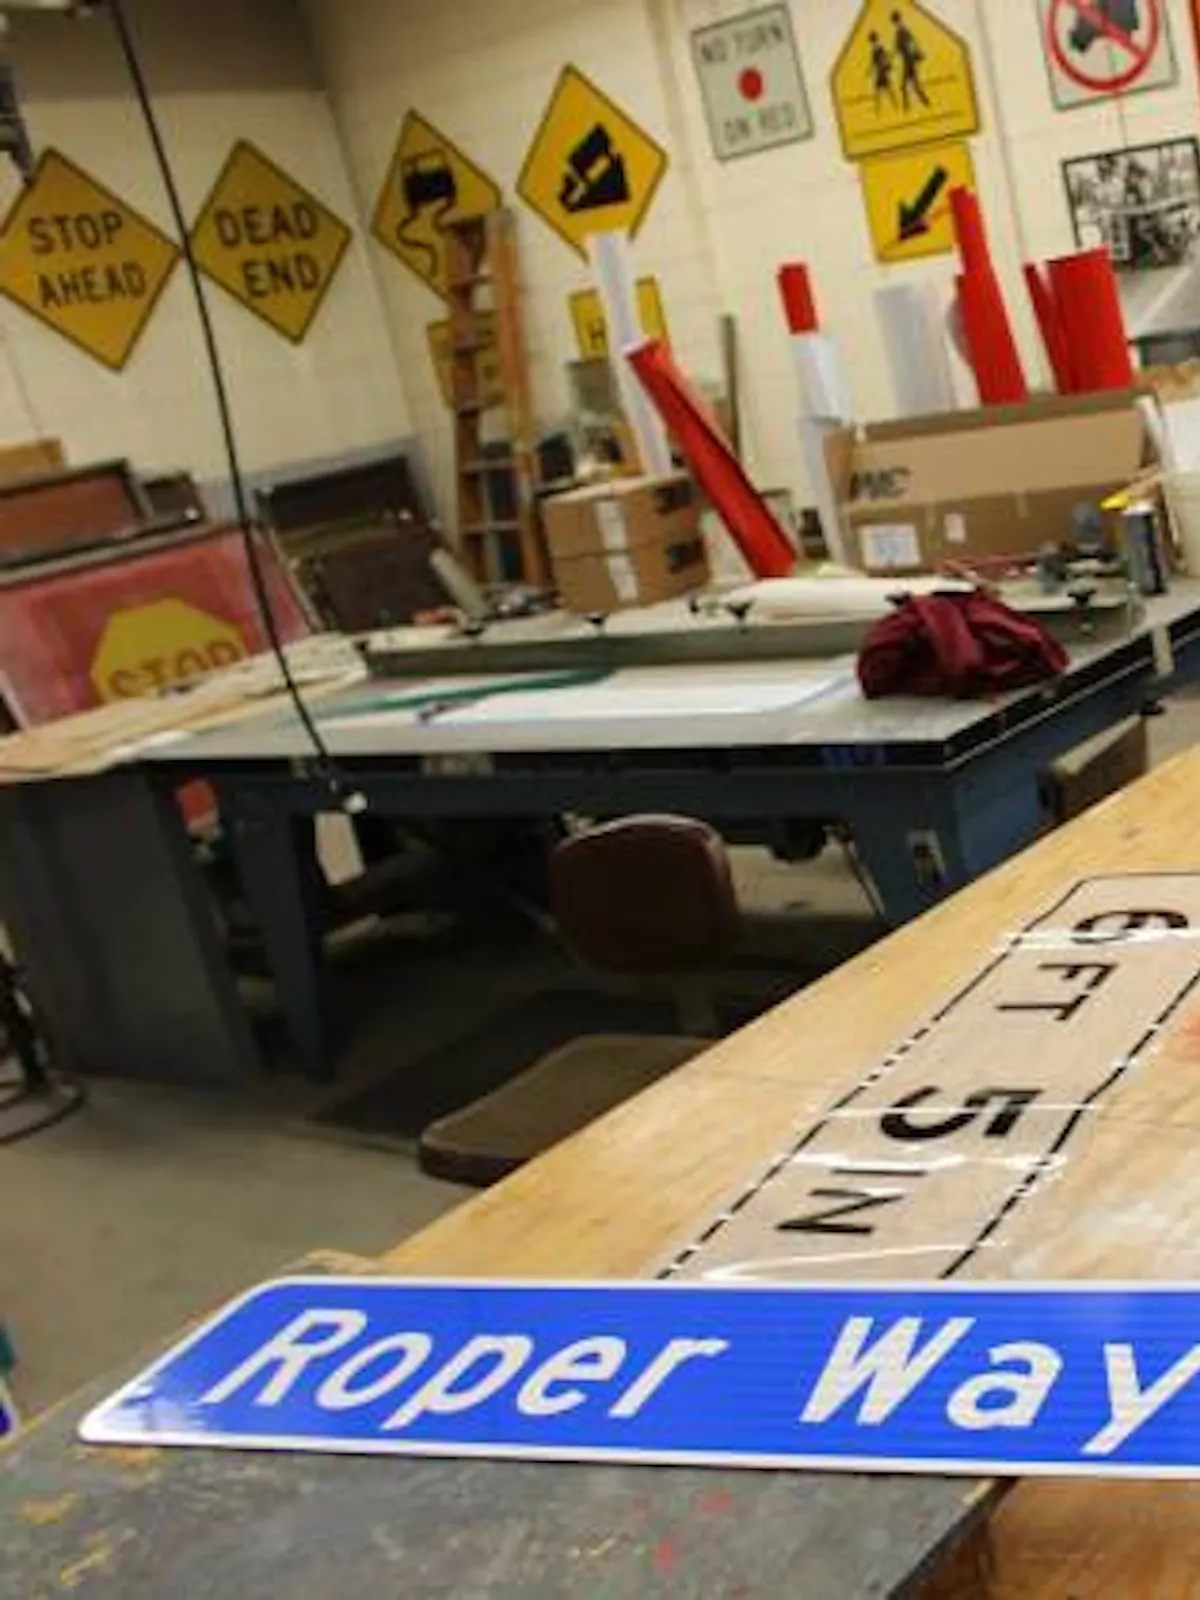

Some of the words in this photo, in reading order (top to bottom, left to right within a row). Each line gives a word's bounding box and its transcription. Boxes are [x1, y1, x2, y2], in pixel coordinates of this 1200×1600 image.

[699, 36, 729, 63] NO
[731, 20, 785, 54] TURN
[722, 116, 751, 145] ON
[757, 102, 798, 138] RED
[26, 211, 123, 254] STOP
[213, 203, 319, 247] DEAD
[37, 262, 147, 308] AHEAD
[242, 254, 321, 297] END
[201, 1308, 730, 1432] Roper
